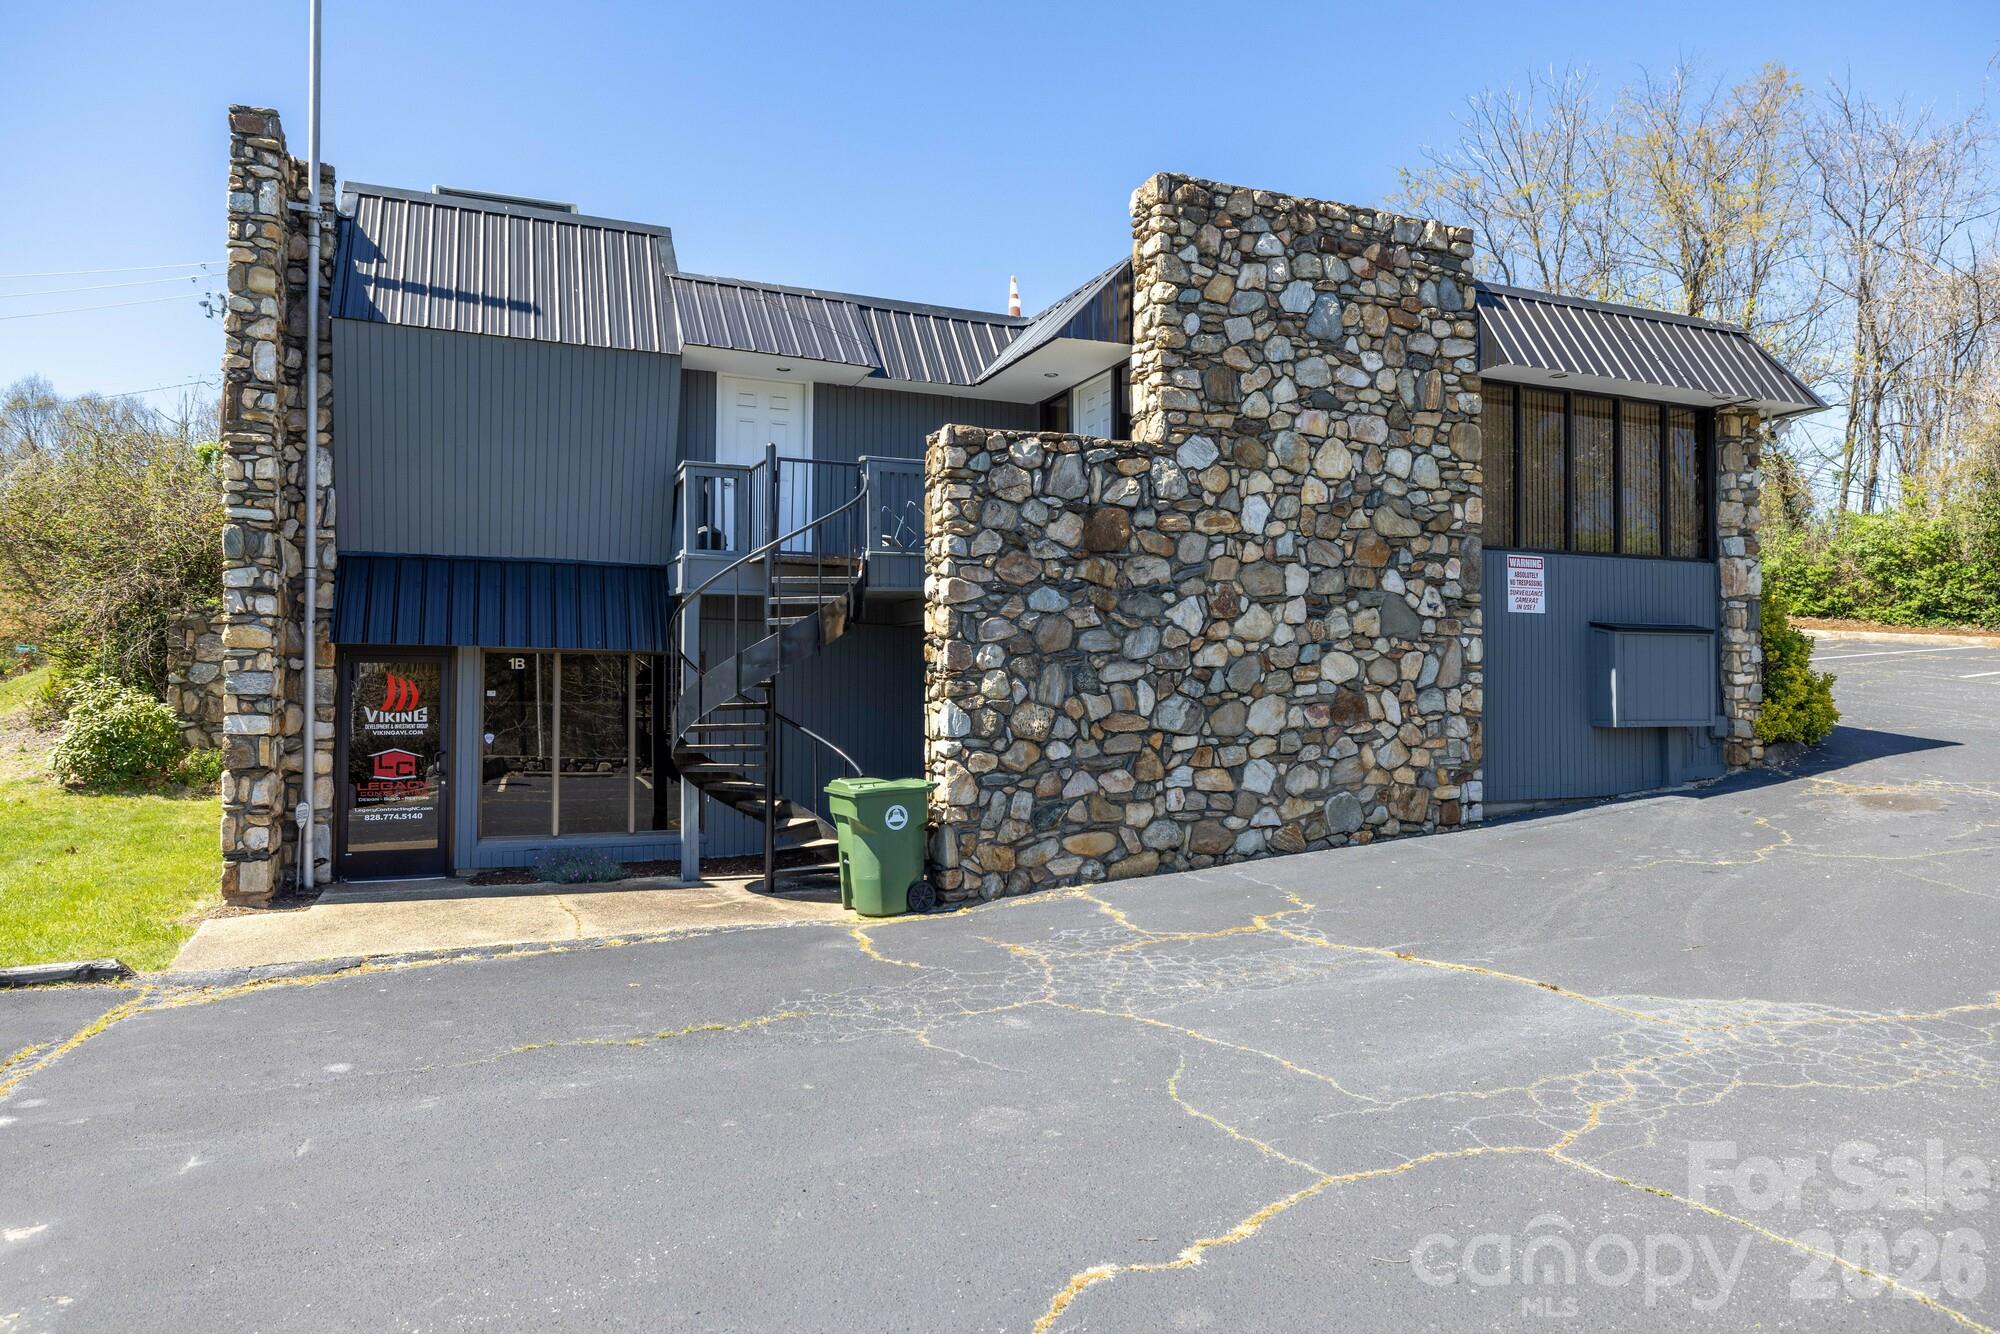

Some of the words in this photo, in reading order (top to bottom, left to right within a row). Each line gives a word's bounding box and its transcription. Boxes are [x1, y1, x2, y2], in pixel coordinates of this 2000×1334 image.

[1510, 558, 1542, 568] WARNING
[1514, 571, 1538, 579] ABSOLUTELY
[1510, 589, 1543, 597] SURVEILLANCE
[508, 657, 525, 670] 1B
[363, 706, 428, 723] VIKING
[357, 781, 432, 791] LEGACY
[364, 812, 423, 821] 828.774.5140
